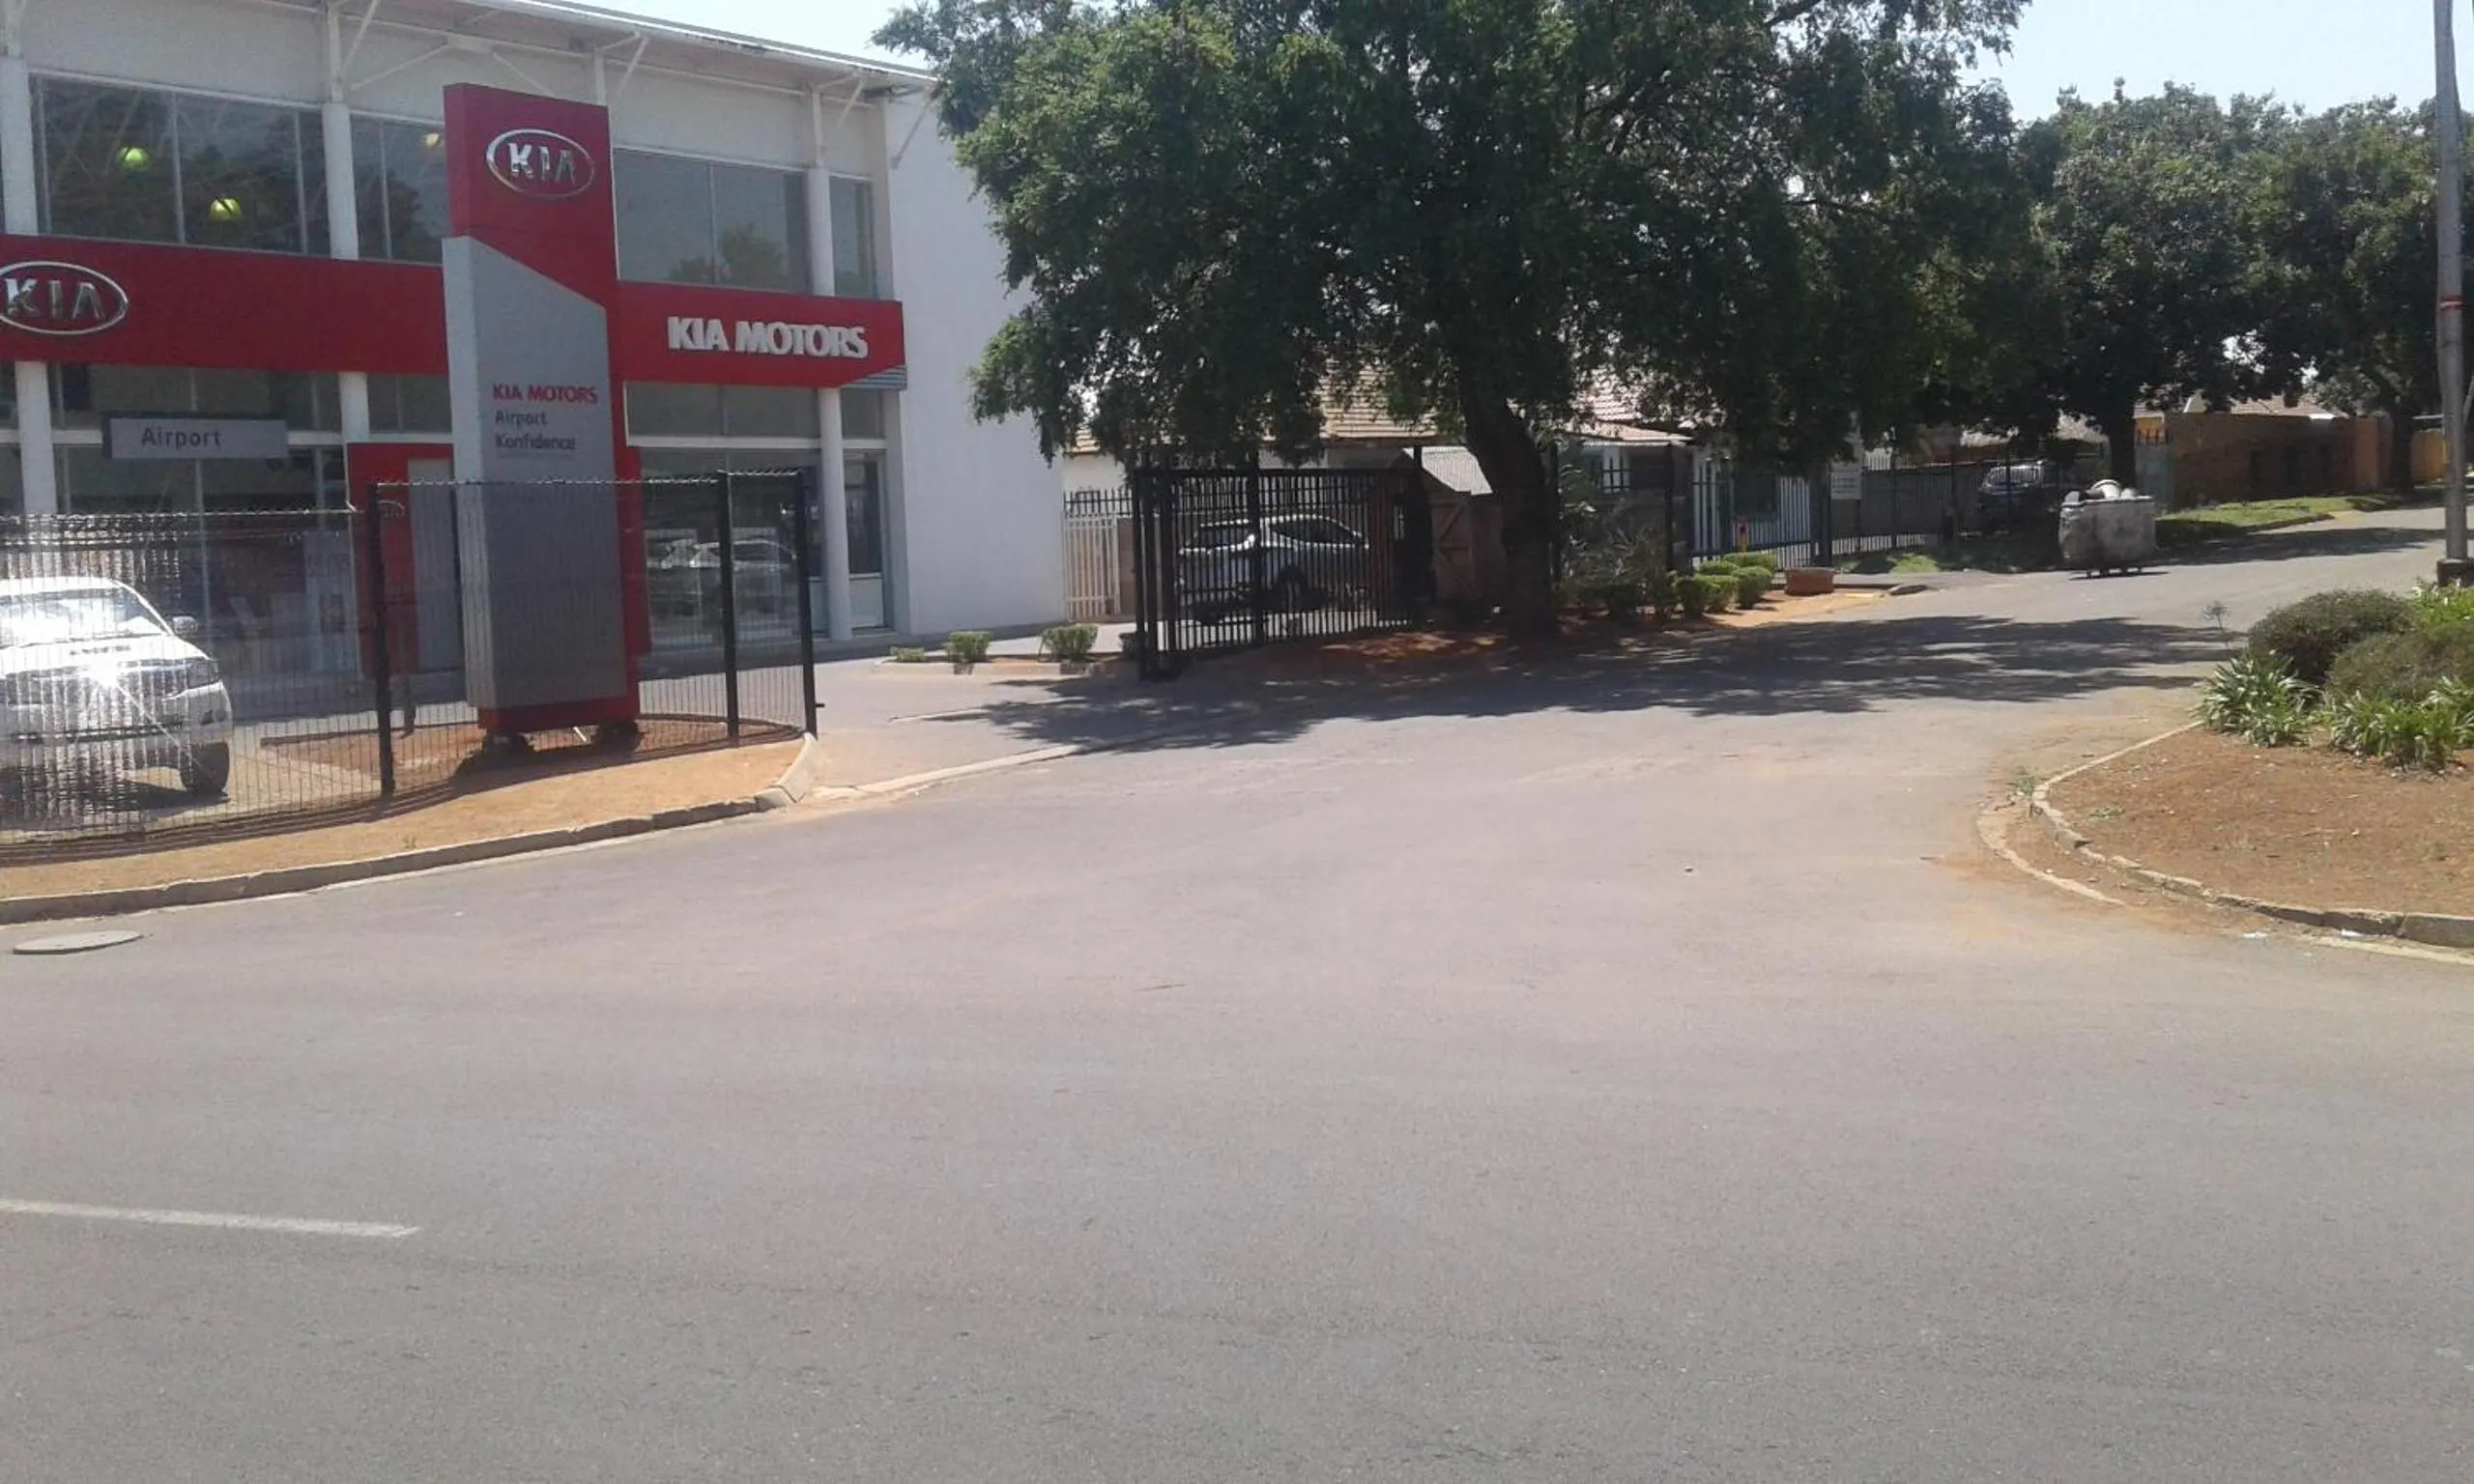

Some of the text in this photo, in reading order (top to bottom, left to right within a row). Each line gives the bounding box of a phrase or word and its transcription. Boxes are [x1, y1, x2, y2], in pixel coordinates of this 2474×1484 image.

[507, 142, 577, 186] KIA
[4, 277, 105, 320] KIA
[667, 316, 869, 359] KIA MOTORS
[492, 383, 598, 404] KIA MOTORS
[495, 409, 548, 427] Airport
[141, 426, 222, 449] Airport
[494, 432, 577, 450] Konfidence
